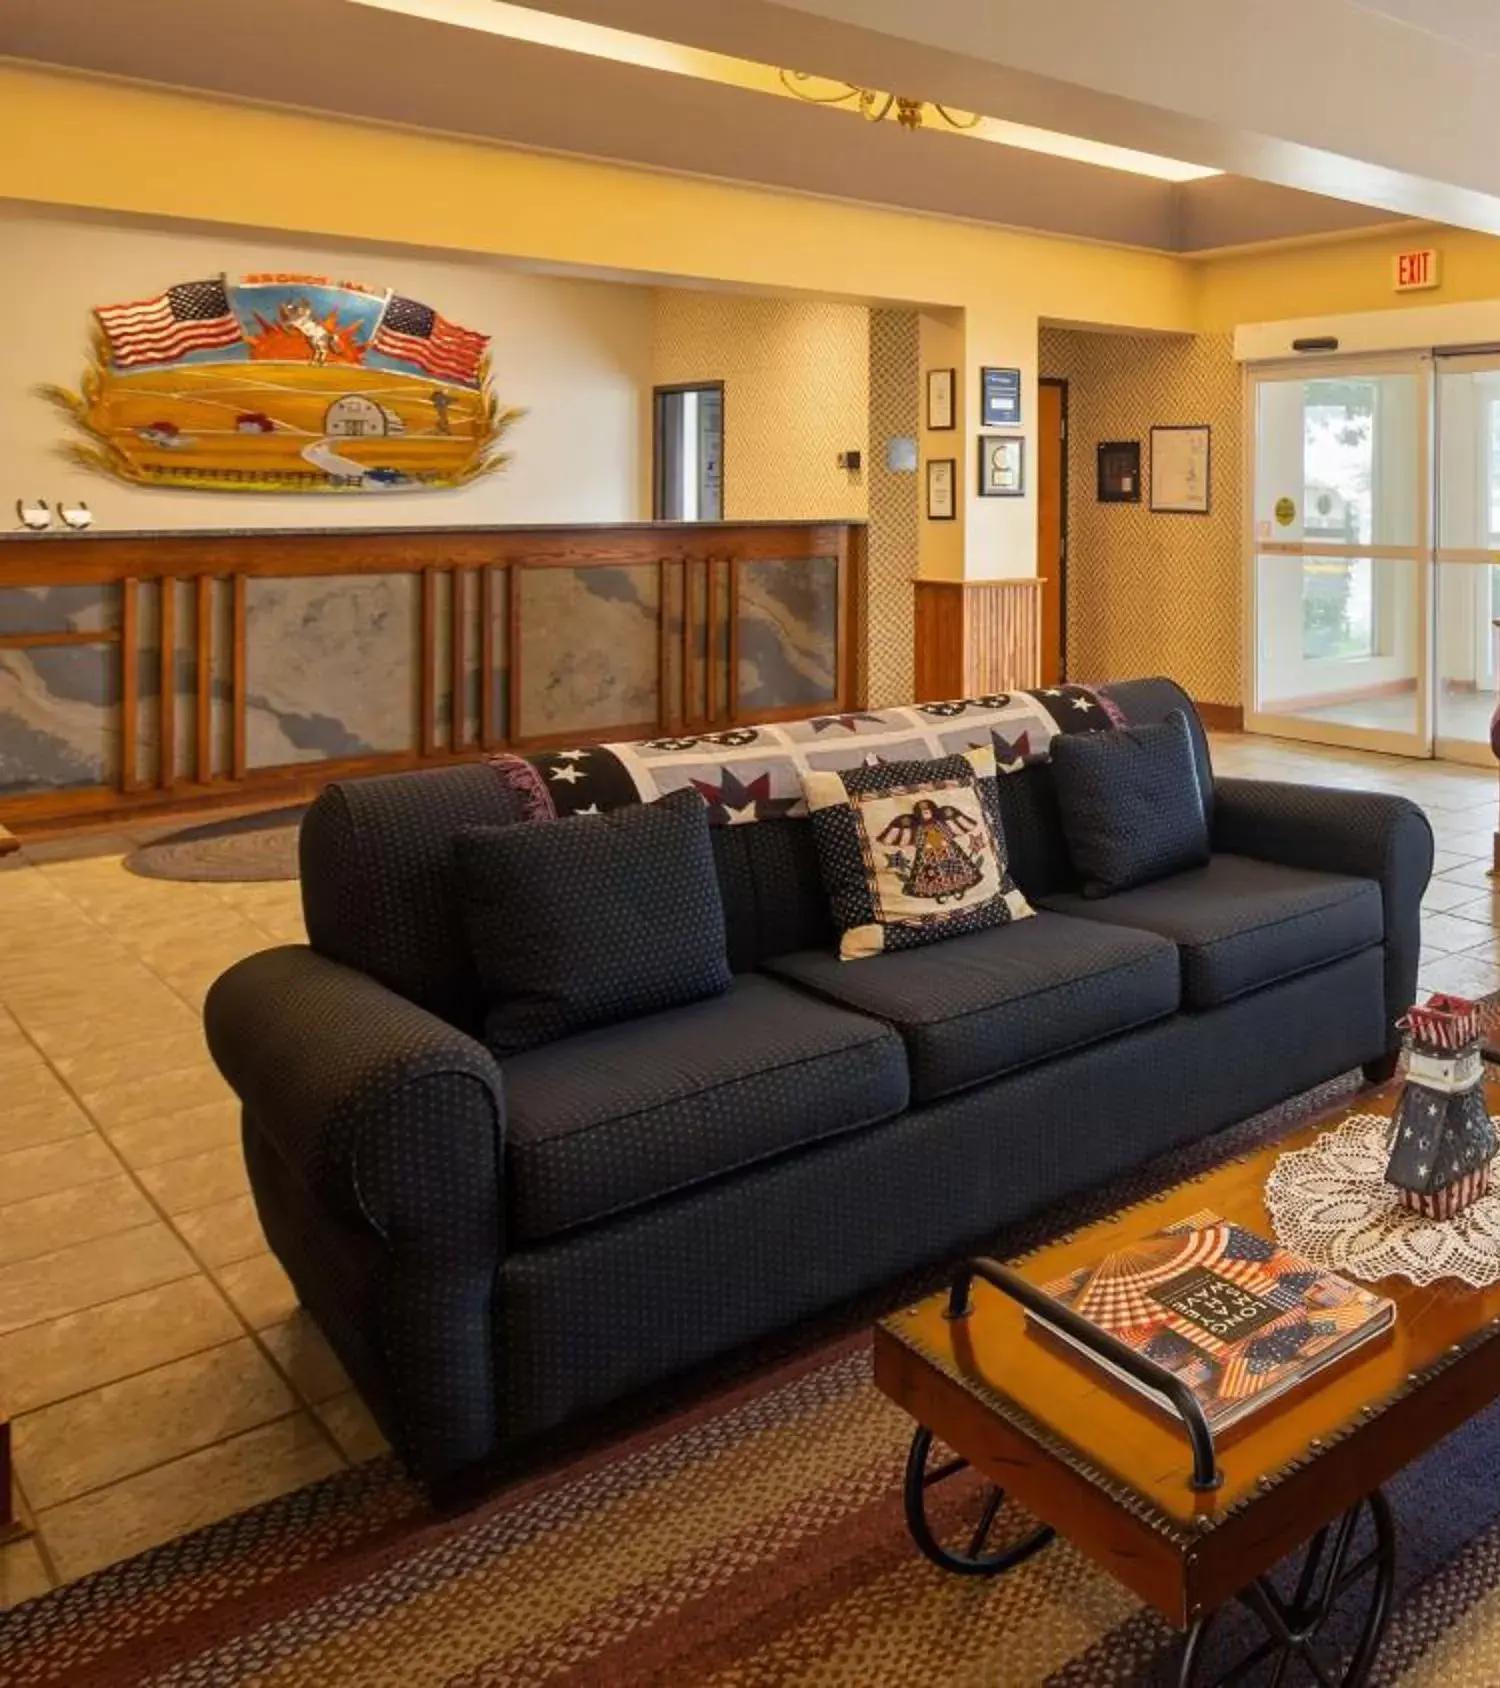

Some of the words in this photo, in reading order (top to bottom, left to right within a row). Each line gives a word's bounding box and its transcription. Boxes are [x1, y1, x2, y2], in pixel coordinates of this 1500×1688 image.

[1399, 251, 1430, 285] EXIT
[1171, 1281, 1230, 1312] WAVE
[1183, 1287, 1241, 1320] SHE
[1199, 1294, 1253, 1327] MAY
[1210, 1301, 1268, 1335] LONG
